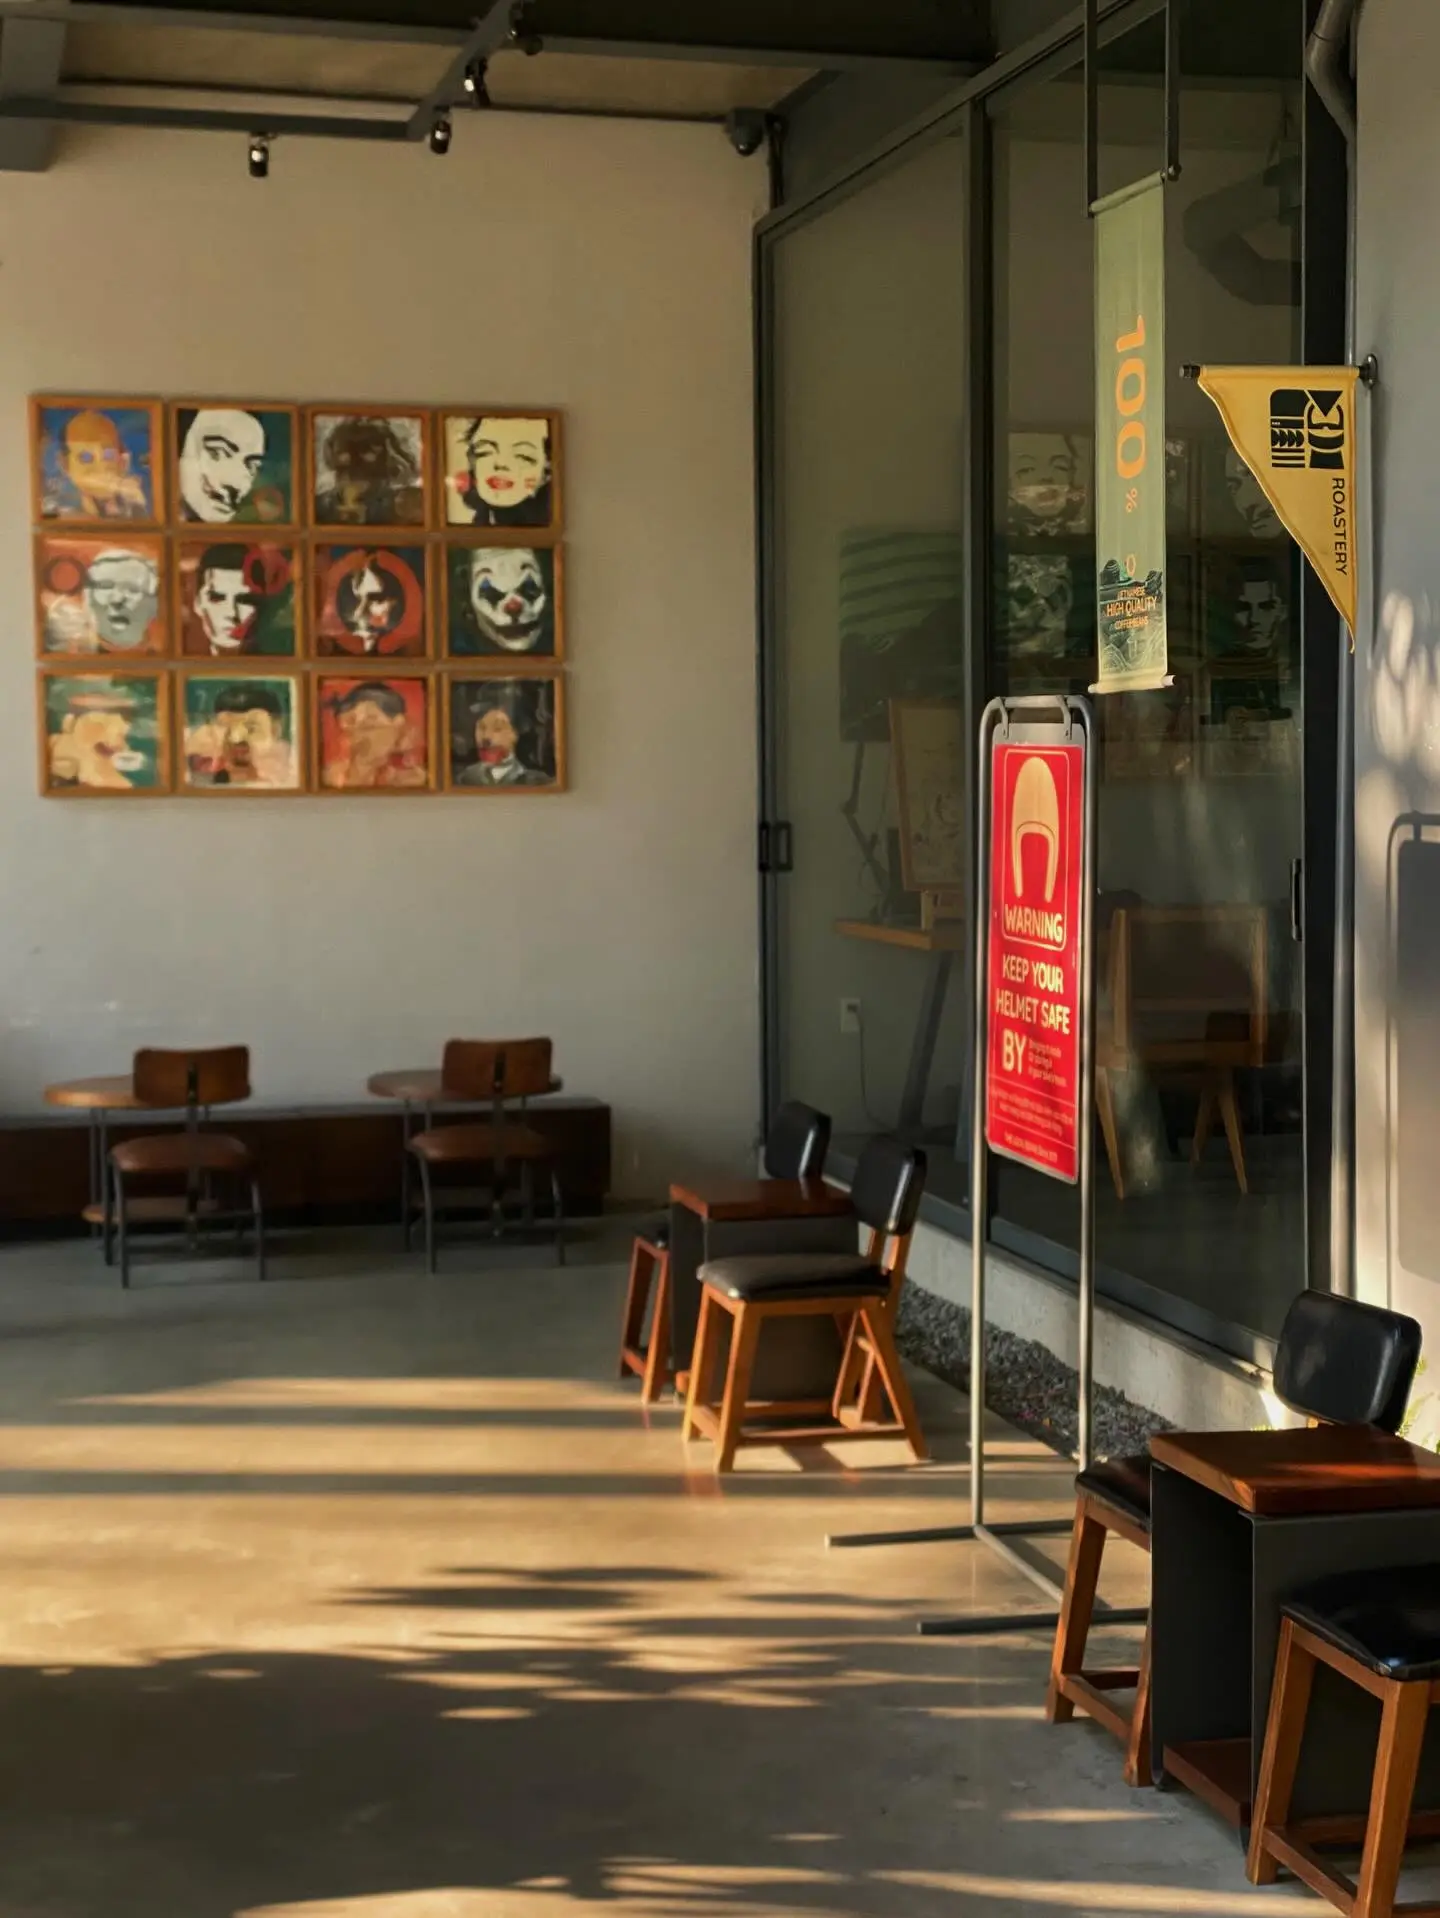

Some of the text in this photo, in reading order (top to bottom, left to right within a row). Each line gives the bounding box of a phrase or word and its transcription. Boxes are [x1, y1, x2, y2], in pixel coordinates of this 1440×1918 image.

[1332, 477, 1347, 576] ROASTERY
[1107, 596, 1157, 617] HIGH QUALITY
[1004, 904, 1063, 943] WARNING
[1002, 954, 1064, 994] KEEP YOUR
[996, 987, 1070, 1035] HELMET SAFE
[1002, 1028, 1027, 1075] BY
